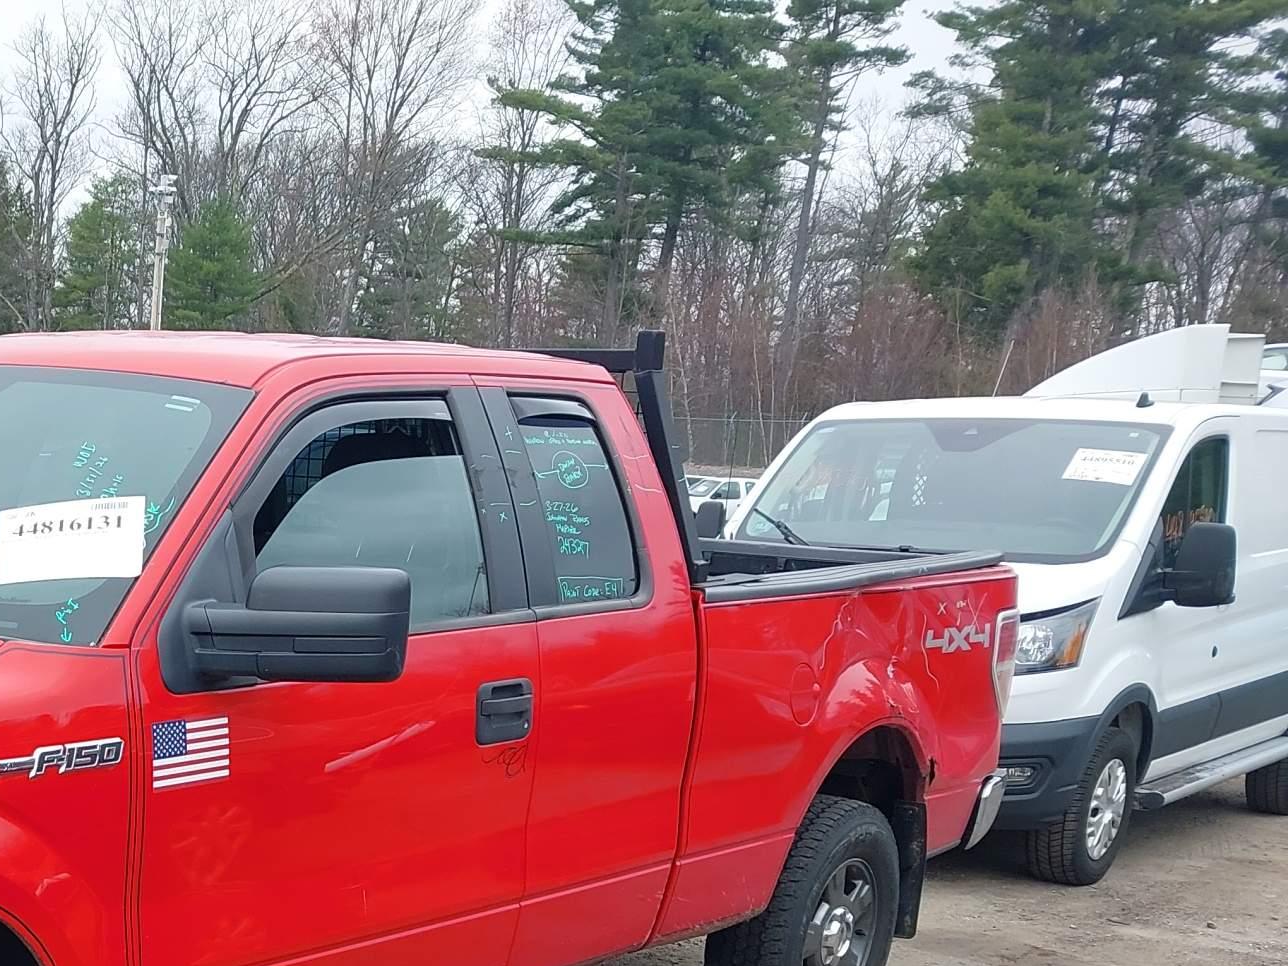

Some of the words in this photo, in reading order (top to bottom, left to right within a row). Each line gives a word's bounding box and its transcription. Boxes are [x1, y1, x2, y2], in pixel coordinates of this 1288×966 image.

[12, 514, 123, 537] 44816131
[605, 582, 617, 596] E4
[925, 623, 991, 654] 4X4
[29, 737, 124, 778] F-150
